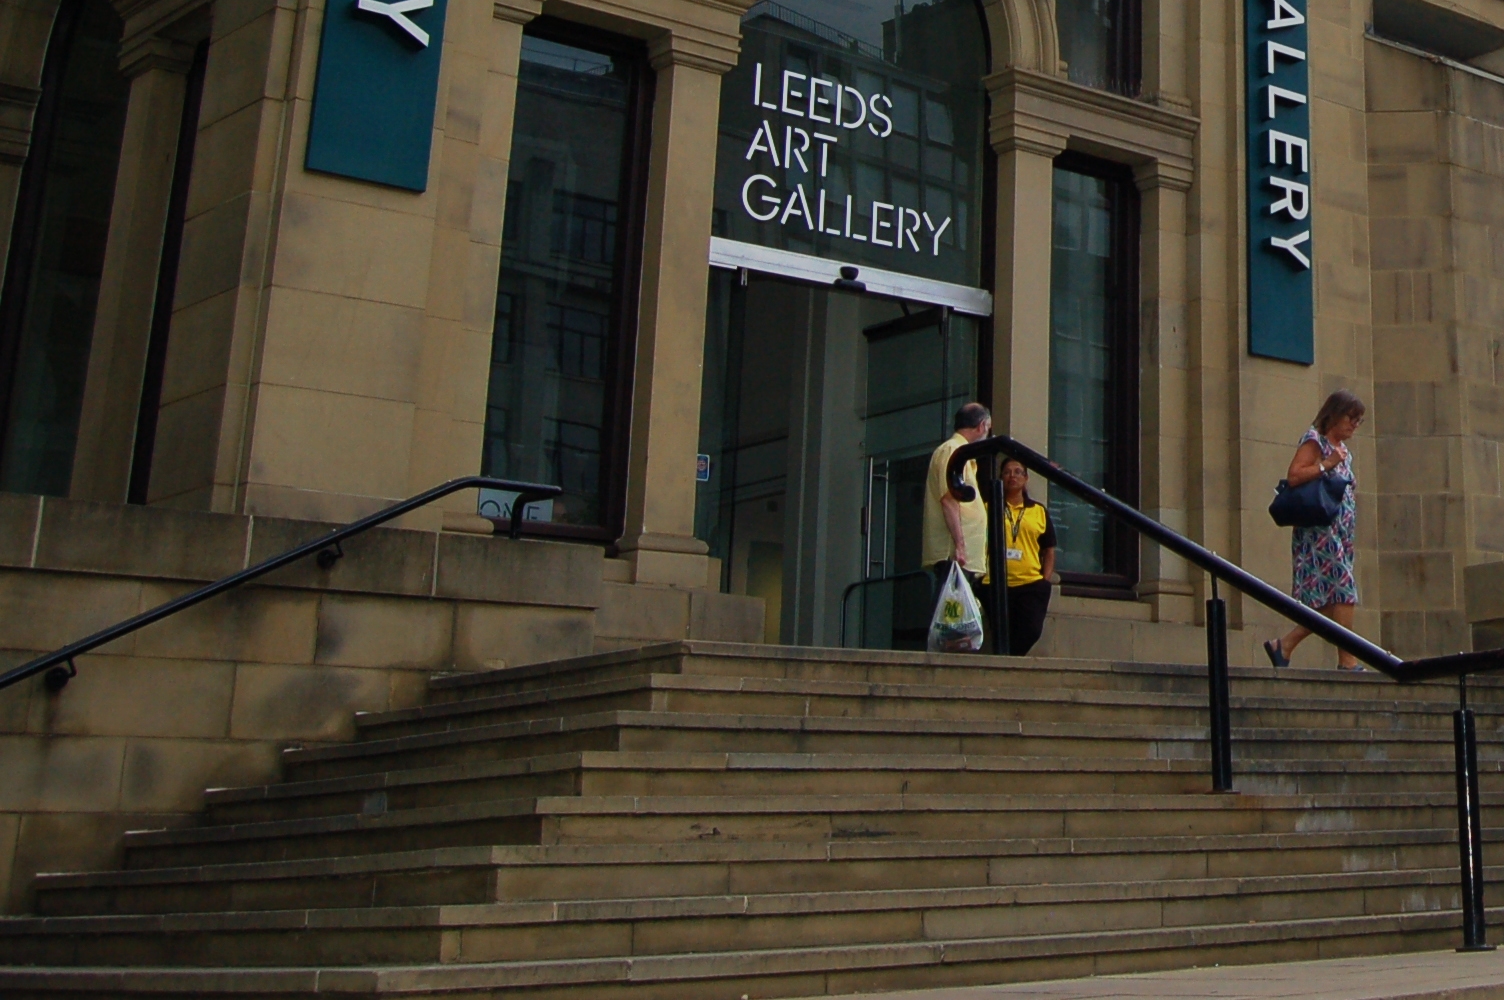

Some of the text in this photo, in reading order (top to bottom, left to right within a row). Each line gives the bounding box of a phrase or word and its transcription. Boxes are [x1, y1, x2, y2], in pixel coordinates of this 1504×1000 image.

[753, 62, 893, 138] LEEDS
[745, 119, 838, 177] ART
[742, 173, 952, 257] GALLERY
